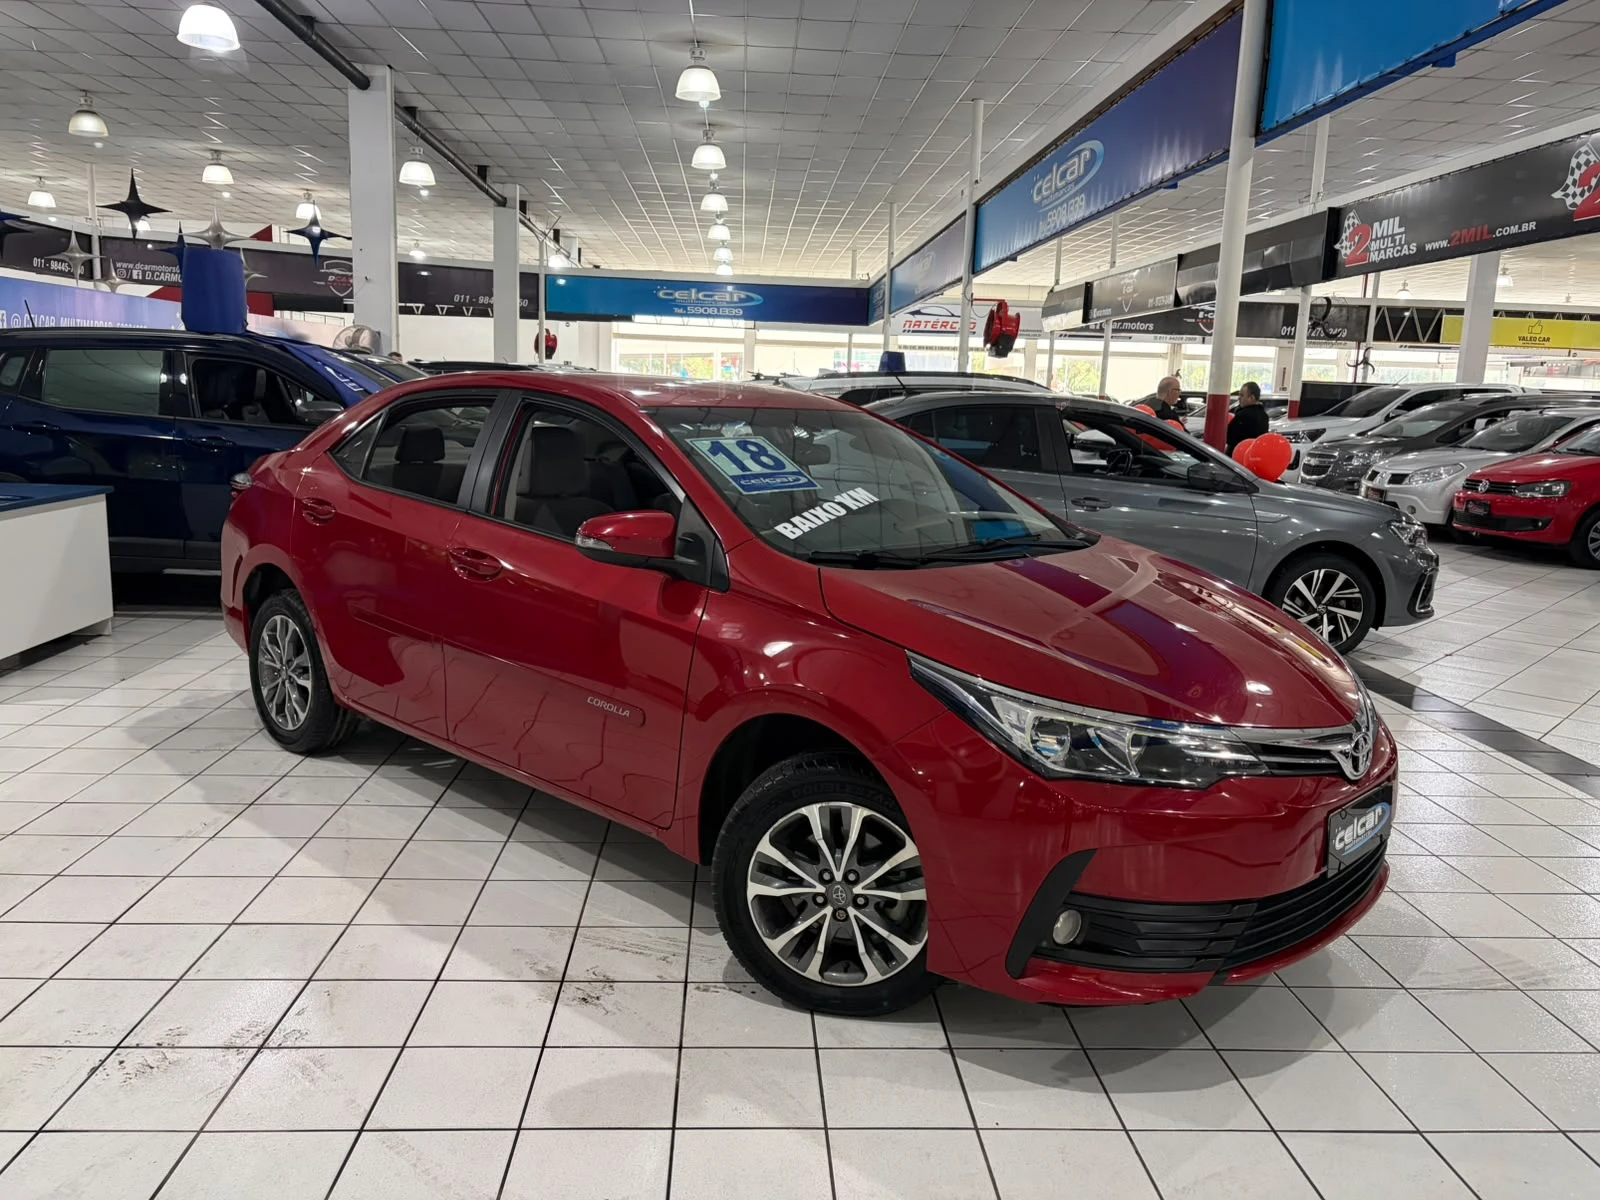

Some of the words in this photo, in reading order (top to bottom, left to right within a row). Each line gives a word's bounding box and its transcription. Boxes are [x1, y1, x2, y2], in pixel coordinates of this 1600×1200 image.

[1033, 147, 1091, 204] celcar
[1344, 223, 1371, 267] 2
[1372, 216, 1405, 239] MIL
[1370, 234, 1406, 251] MULTI
[33, 257, 45, 268] 011
[1369, 243, 1417, 263] MARCAS
[454, 294, 470, 303] 011
[657, 288, 747, 302] celcar
[903, 318, 977, 330] NATÉRCO
[1281, 326, 1296, 336] 011
[707, 440, 787, 473] 18
[774, 500, 847, 540] BAIXO
[834, 487, 880, 511] KM
[587, 696, 630, 717] COROLLA
[1335, 807, 1382, 850] celcar
